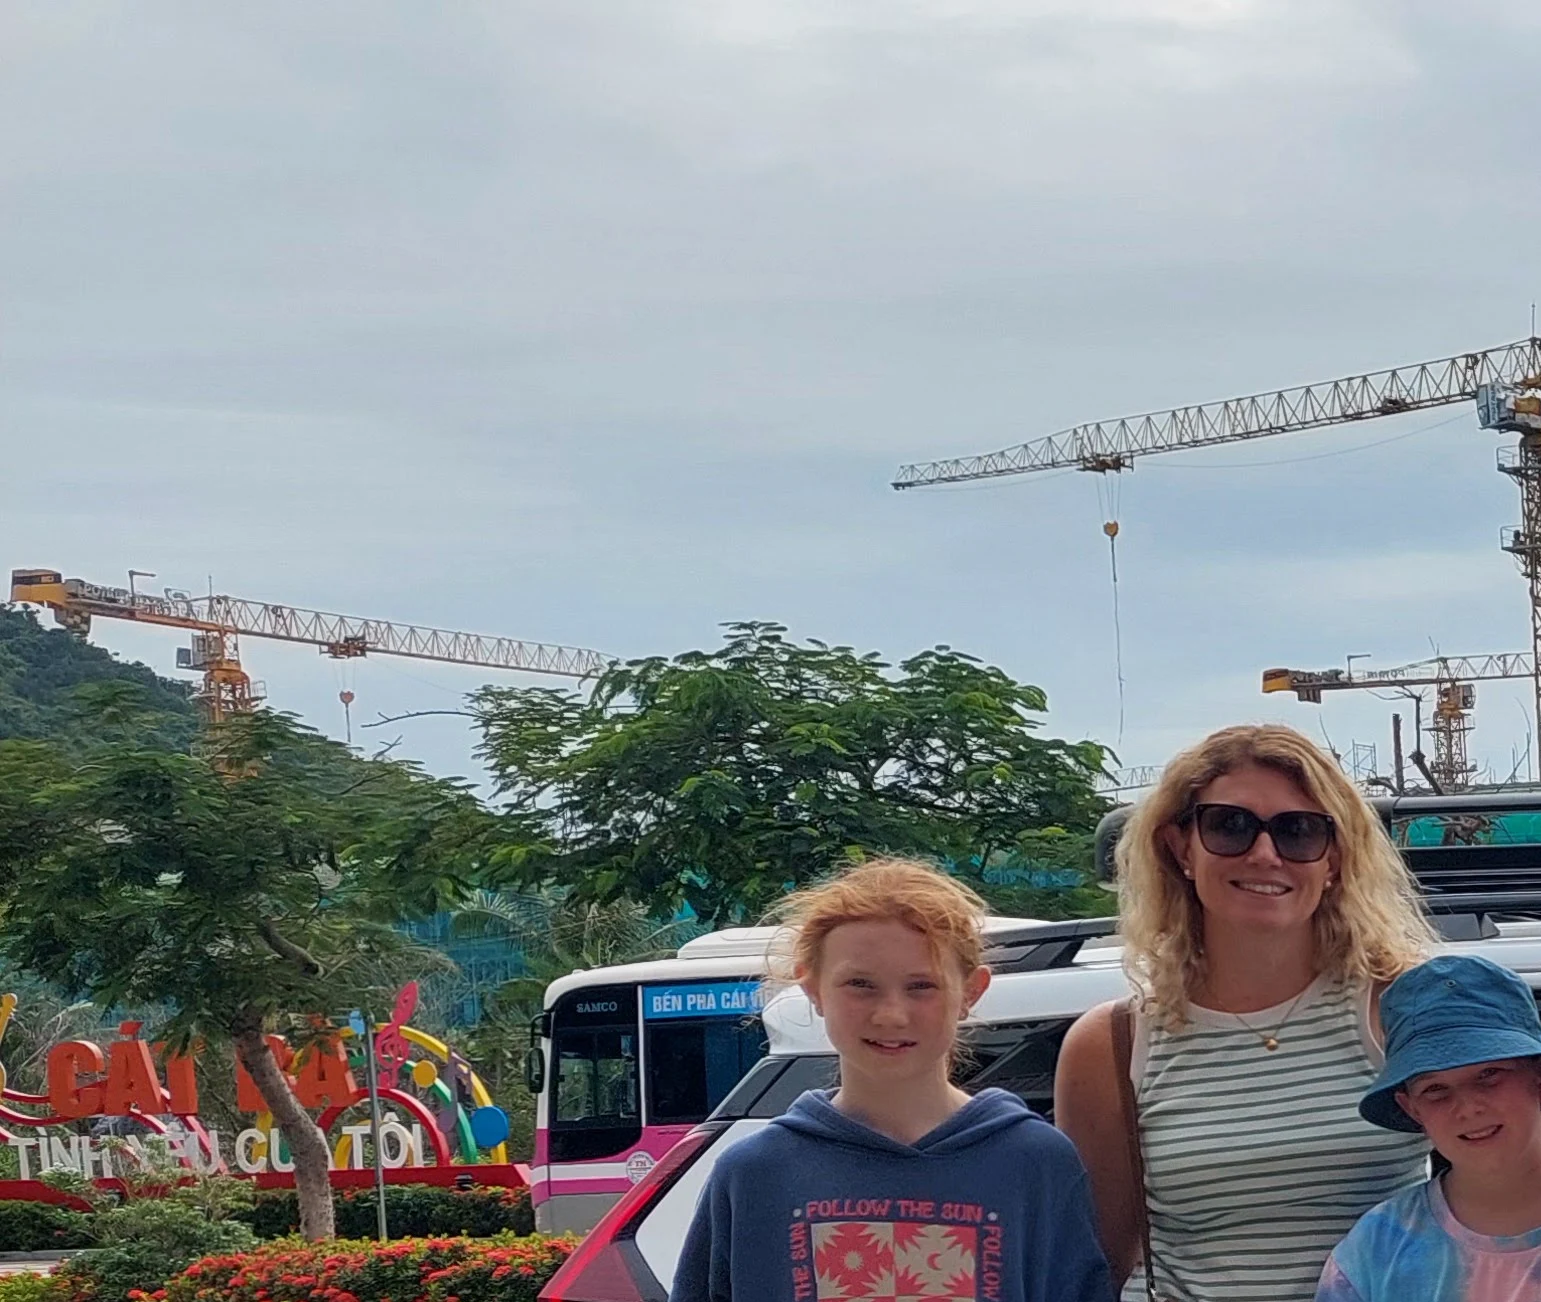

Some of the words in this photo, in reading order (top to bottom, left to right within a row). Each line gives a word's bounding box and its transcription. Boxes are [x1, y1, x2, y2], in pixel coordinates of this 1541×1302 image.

[576, 1001, 618, 1014] SAMCO
[653, 991, 682, 1013] BẾN
[687, 989, 716, 1011] PHÀ
[721, 987, 746, 1009] CÁI
[342, 1111, 425, 1171] TÔI
[806, 1199, 892, 1219] FOLLOW
[896, 1199, 934, 1218] THE
[940, 1203, 984, 1222] SUN
[789, 1221, 808, 1261] SUN
[983, 1225, 1004, 1302] FOLLOW
[793, 1267, 812, 1301] THE
